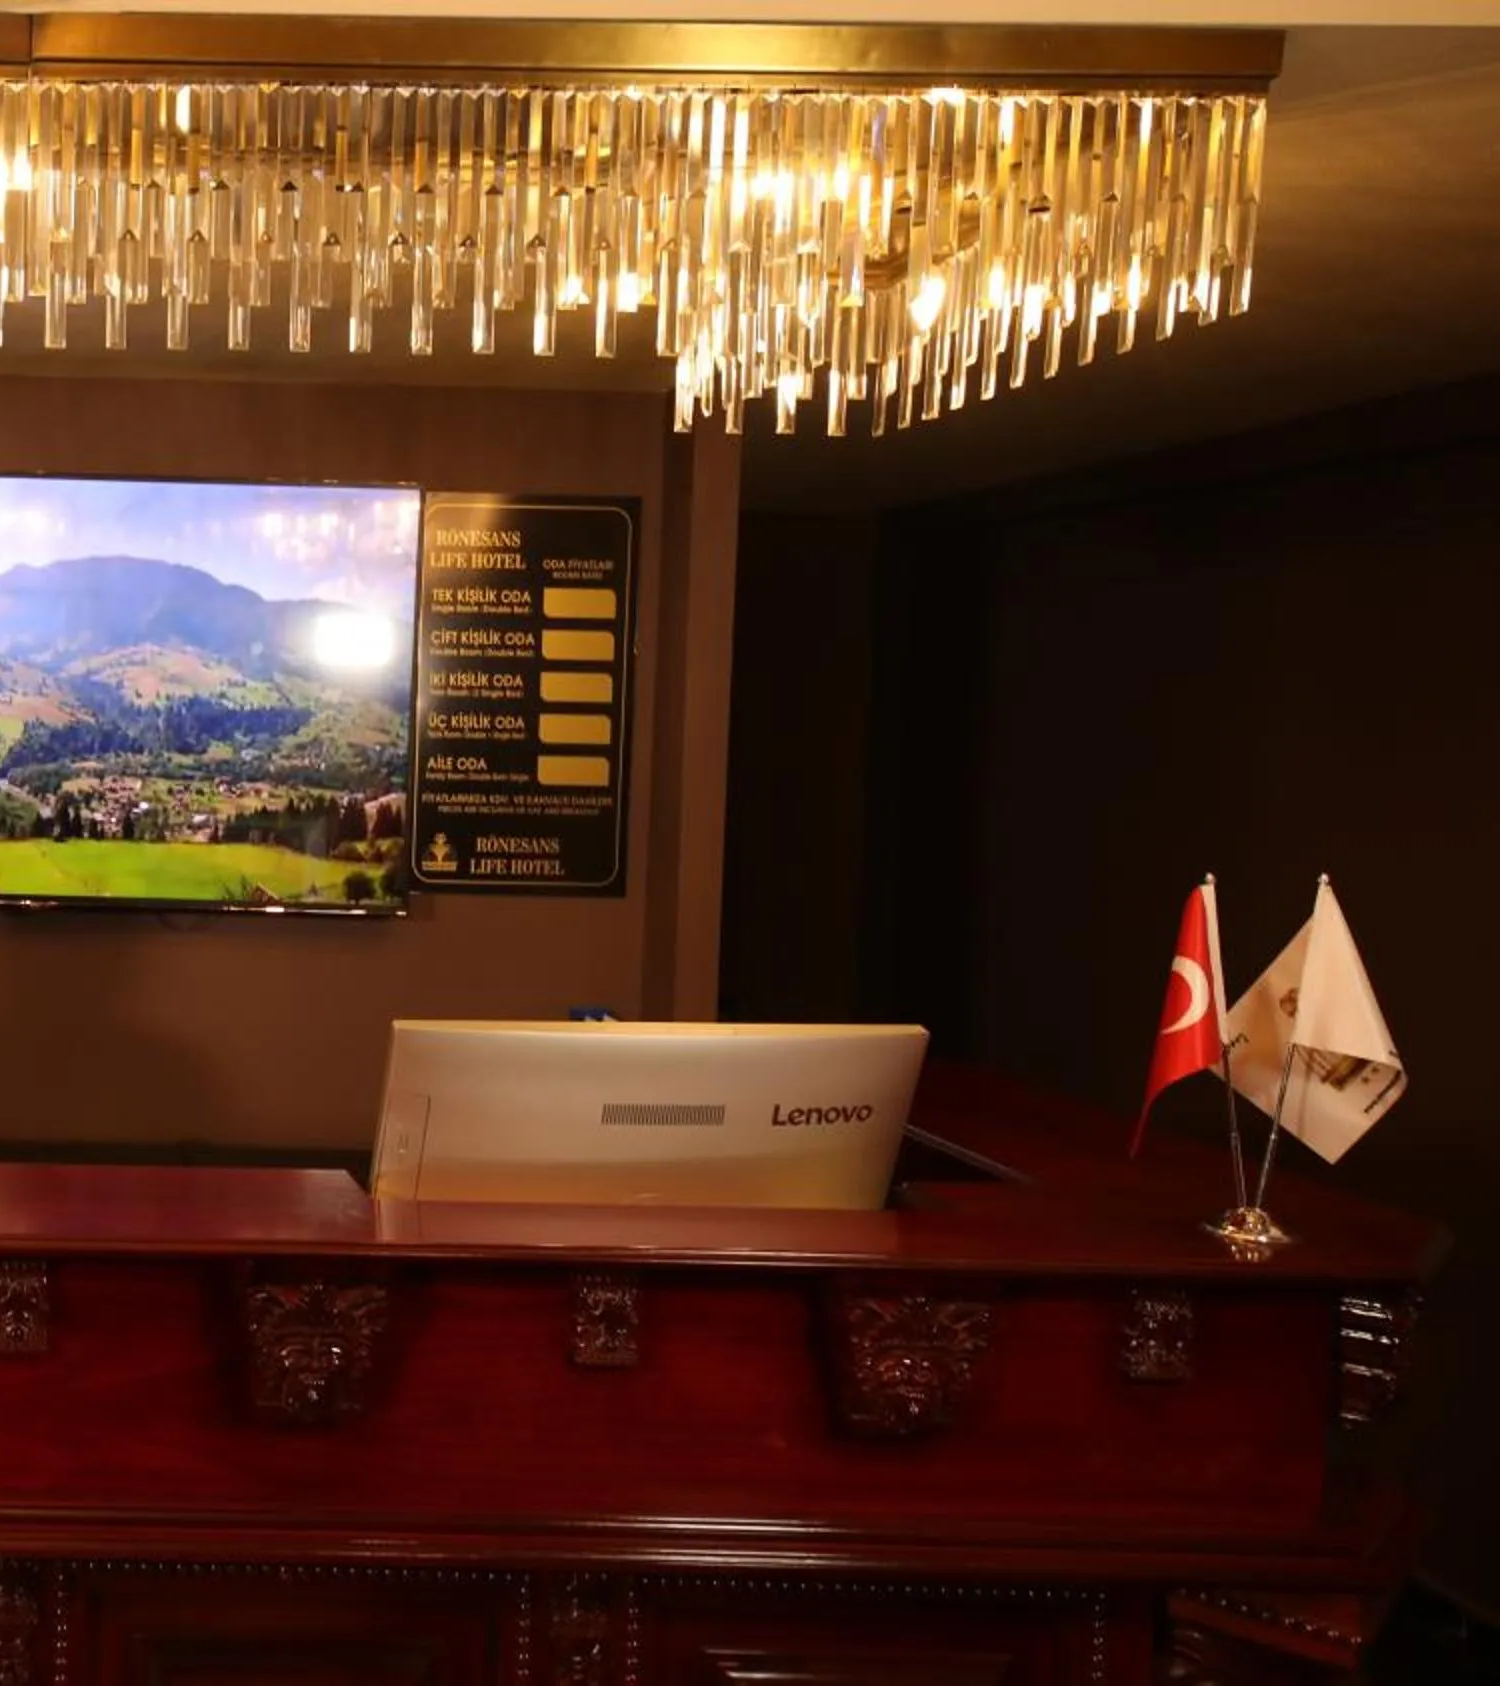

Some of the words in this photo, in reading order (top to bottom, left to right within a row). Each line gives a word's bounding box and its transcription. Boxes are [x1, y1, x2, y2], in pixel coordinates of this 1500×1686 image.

[436, 528, 521, 548] RÖNESANS
[430, 552, 468, 569] LIFE
[471, 552, 526, 570] HOTEL
[432, 588, 453, 602] TEK
[501, 588, 532, 603] ODA
[504, 632, 535, 646] ODA
[493, 674, 524, 688] ODA
[494, 715, 525, 730] ODA
[456, 756, 488, 770] ODA
[476, 834, 560, 854] RÖNESANS
[470, 858, 508, 875] LIFE
[511, 858, 565, 876] HOTEL
[771, 1103, 874, 1126] Lenovo
